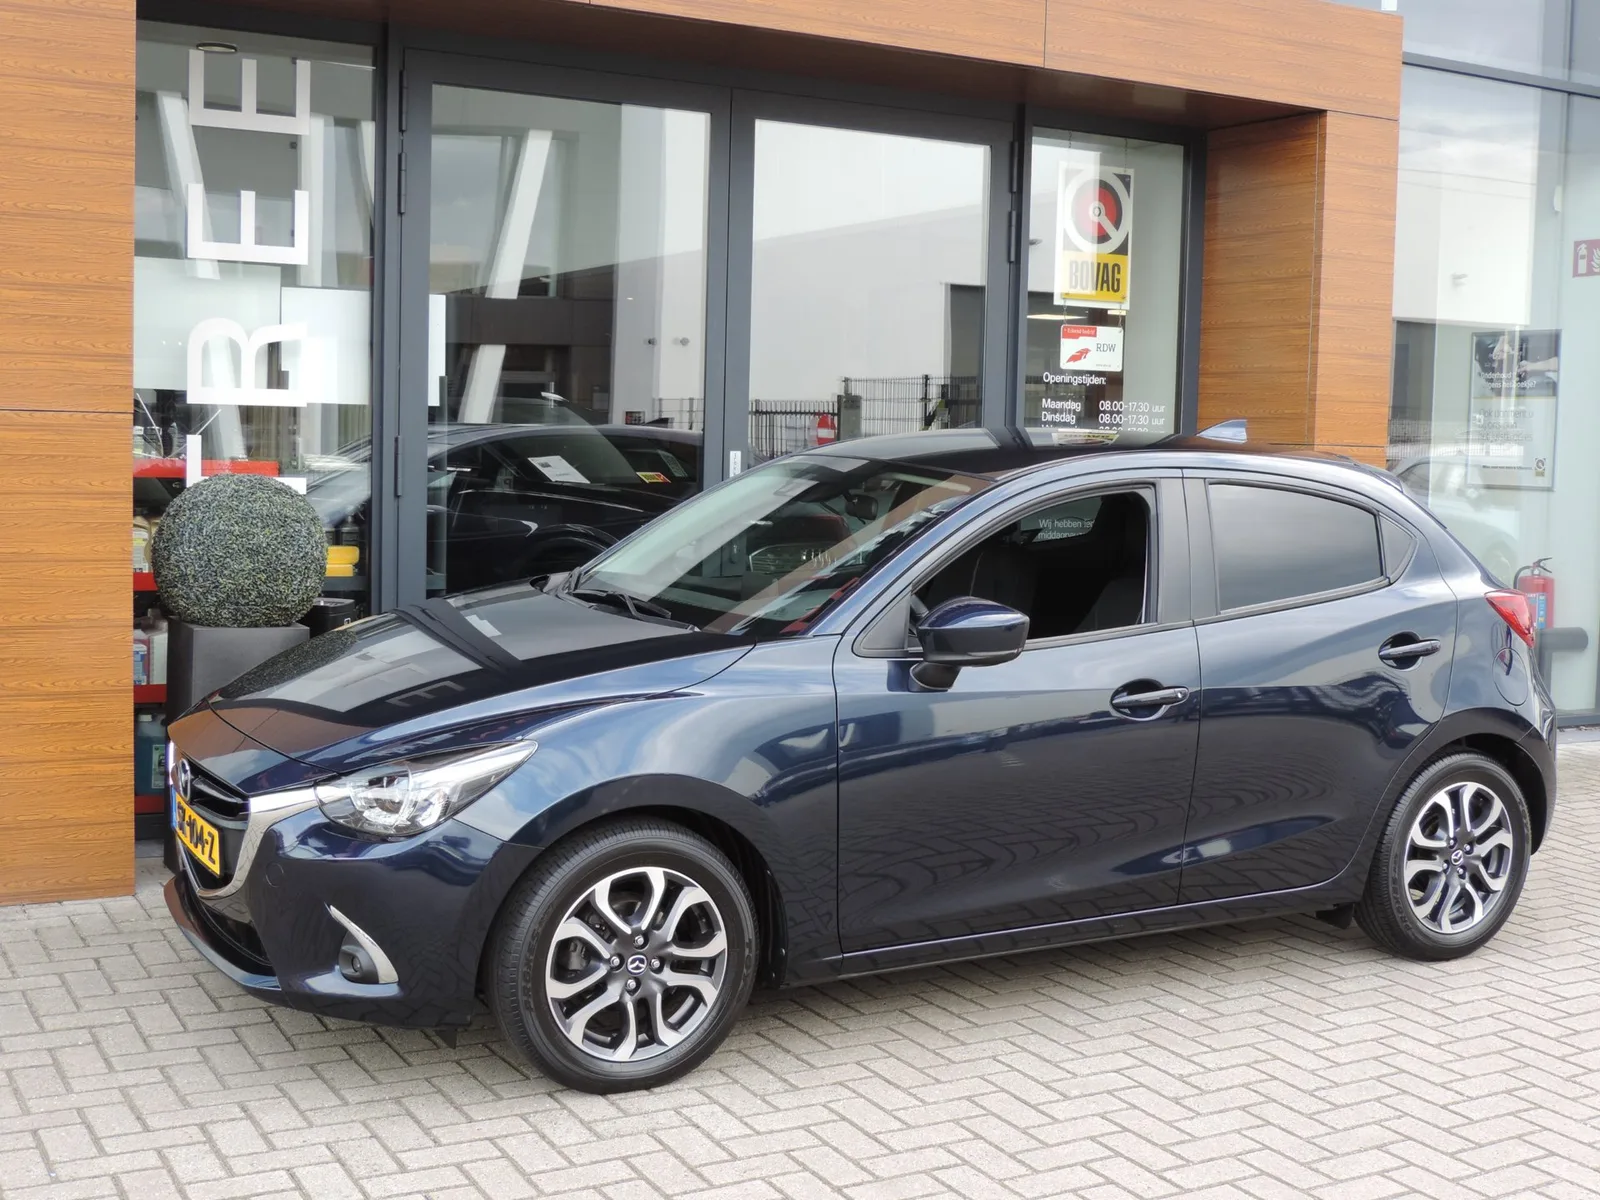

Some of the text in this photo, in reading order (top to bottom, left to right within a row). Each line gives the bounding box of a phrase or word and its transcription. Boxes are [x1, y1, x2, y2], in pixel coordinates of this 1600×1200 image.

[1068, 259, 1121, 293] BOVAG
[1096, 343, 1116, 353] RDW
[1043, 372, 1107, 387] Openingstijden:
[1042, 398, 1165, 413] Maandag 08.00-17.30 uur
[1041, 411, 1165, 425] Dinsdag 08.00-17.30 uur
[1039, 519, 1052, 529] Wij
[1054, 519, 1082, 528] hebben
